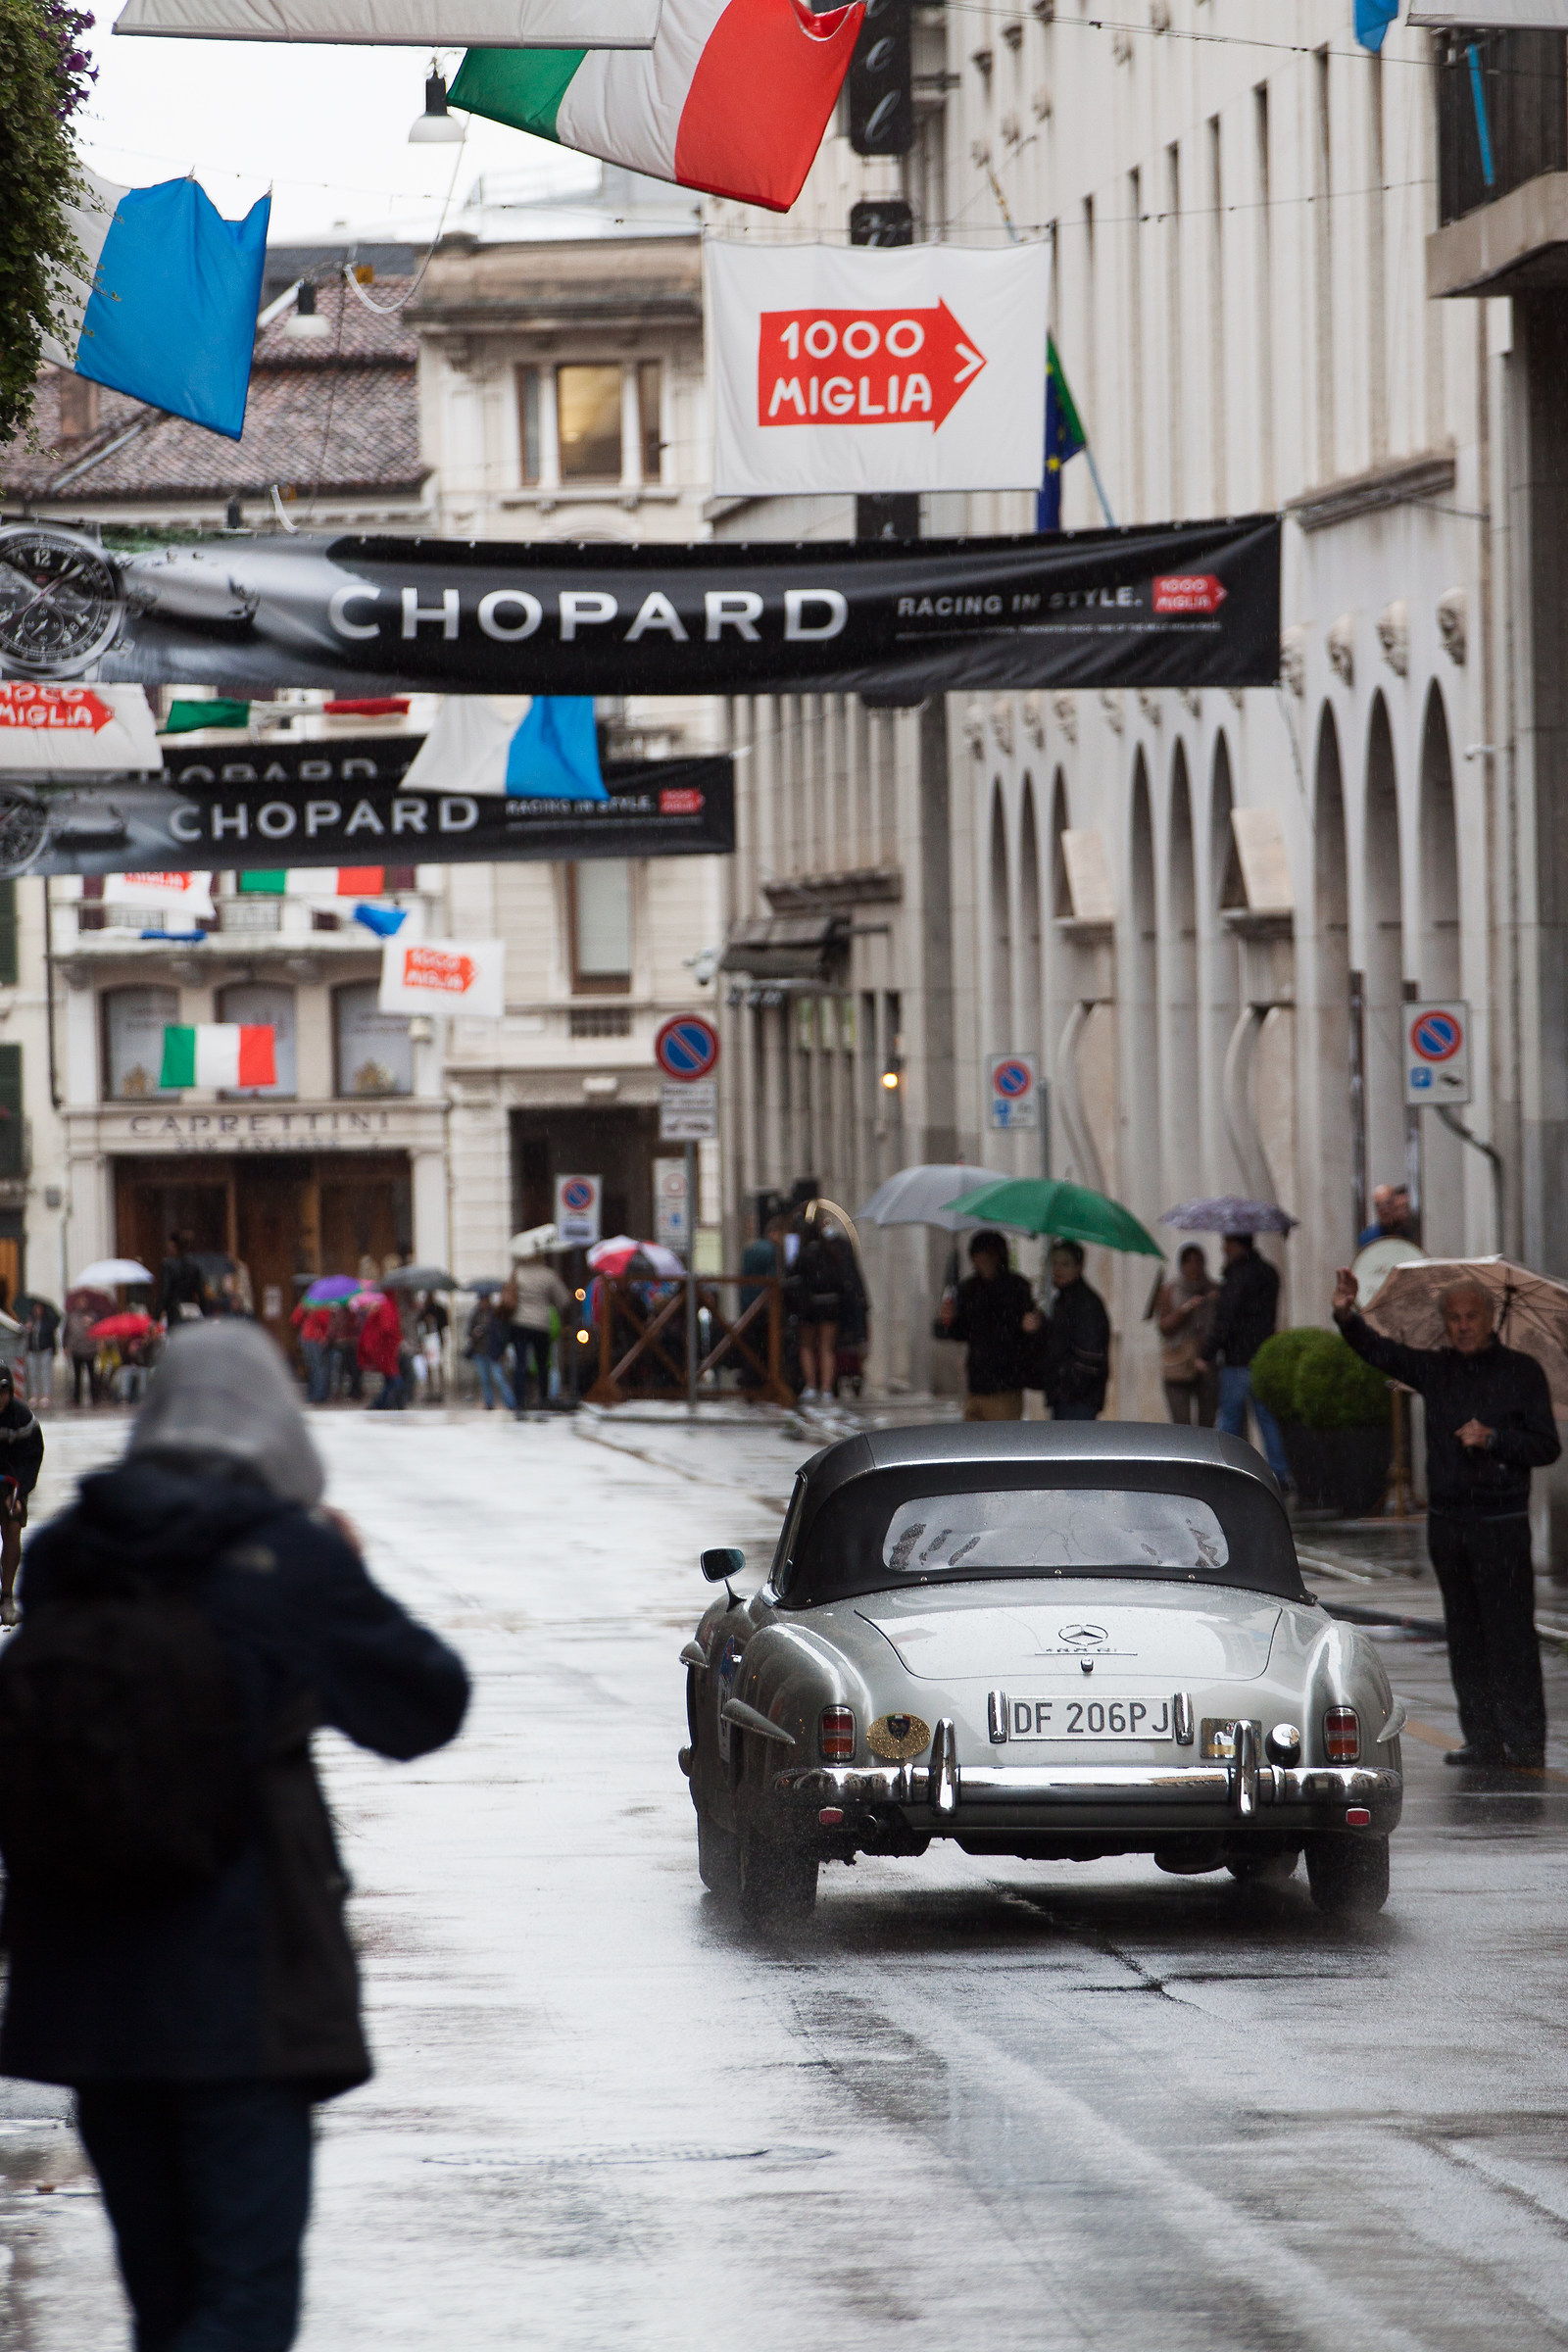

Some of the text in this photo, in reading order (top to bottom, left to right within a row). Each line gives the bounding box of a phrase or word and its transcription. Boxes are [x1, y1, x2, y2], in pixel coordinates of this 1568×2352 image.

[779, 319, 925, 360] 1000
[767, 372, 933, 418] MIGLIA
[897, 586, 1144, 617] RACING IN STYLE.
[1160, 578, 1208, 594] 1000
[328, 585, 849, 642] CHOPARD
[1156, 595, 1211, 610] MIGLIA
[168, 796, 479, 843] CHOPARD
[128, 1110, 389, 1139] CAPRETTINI
[1014, 1702, 1053, 1734] DF
